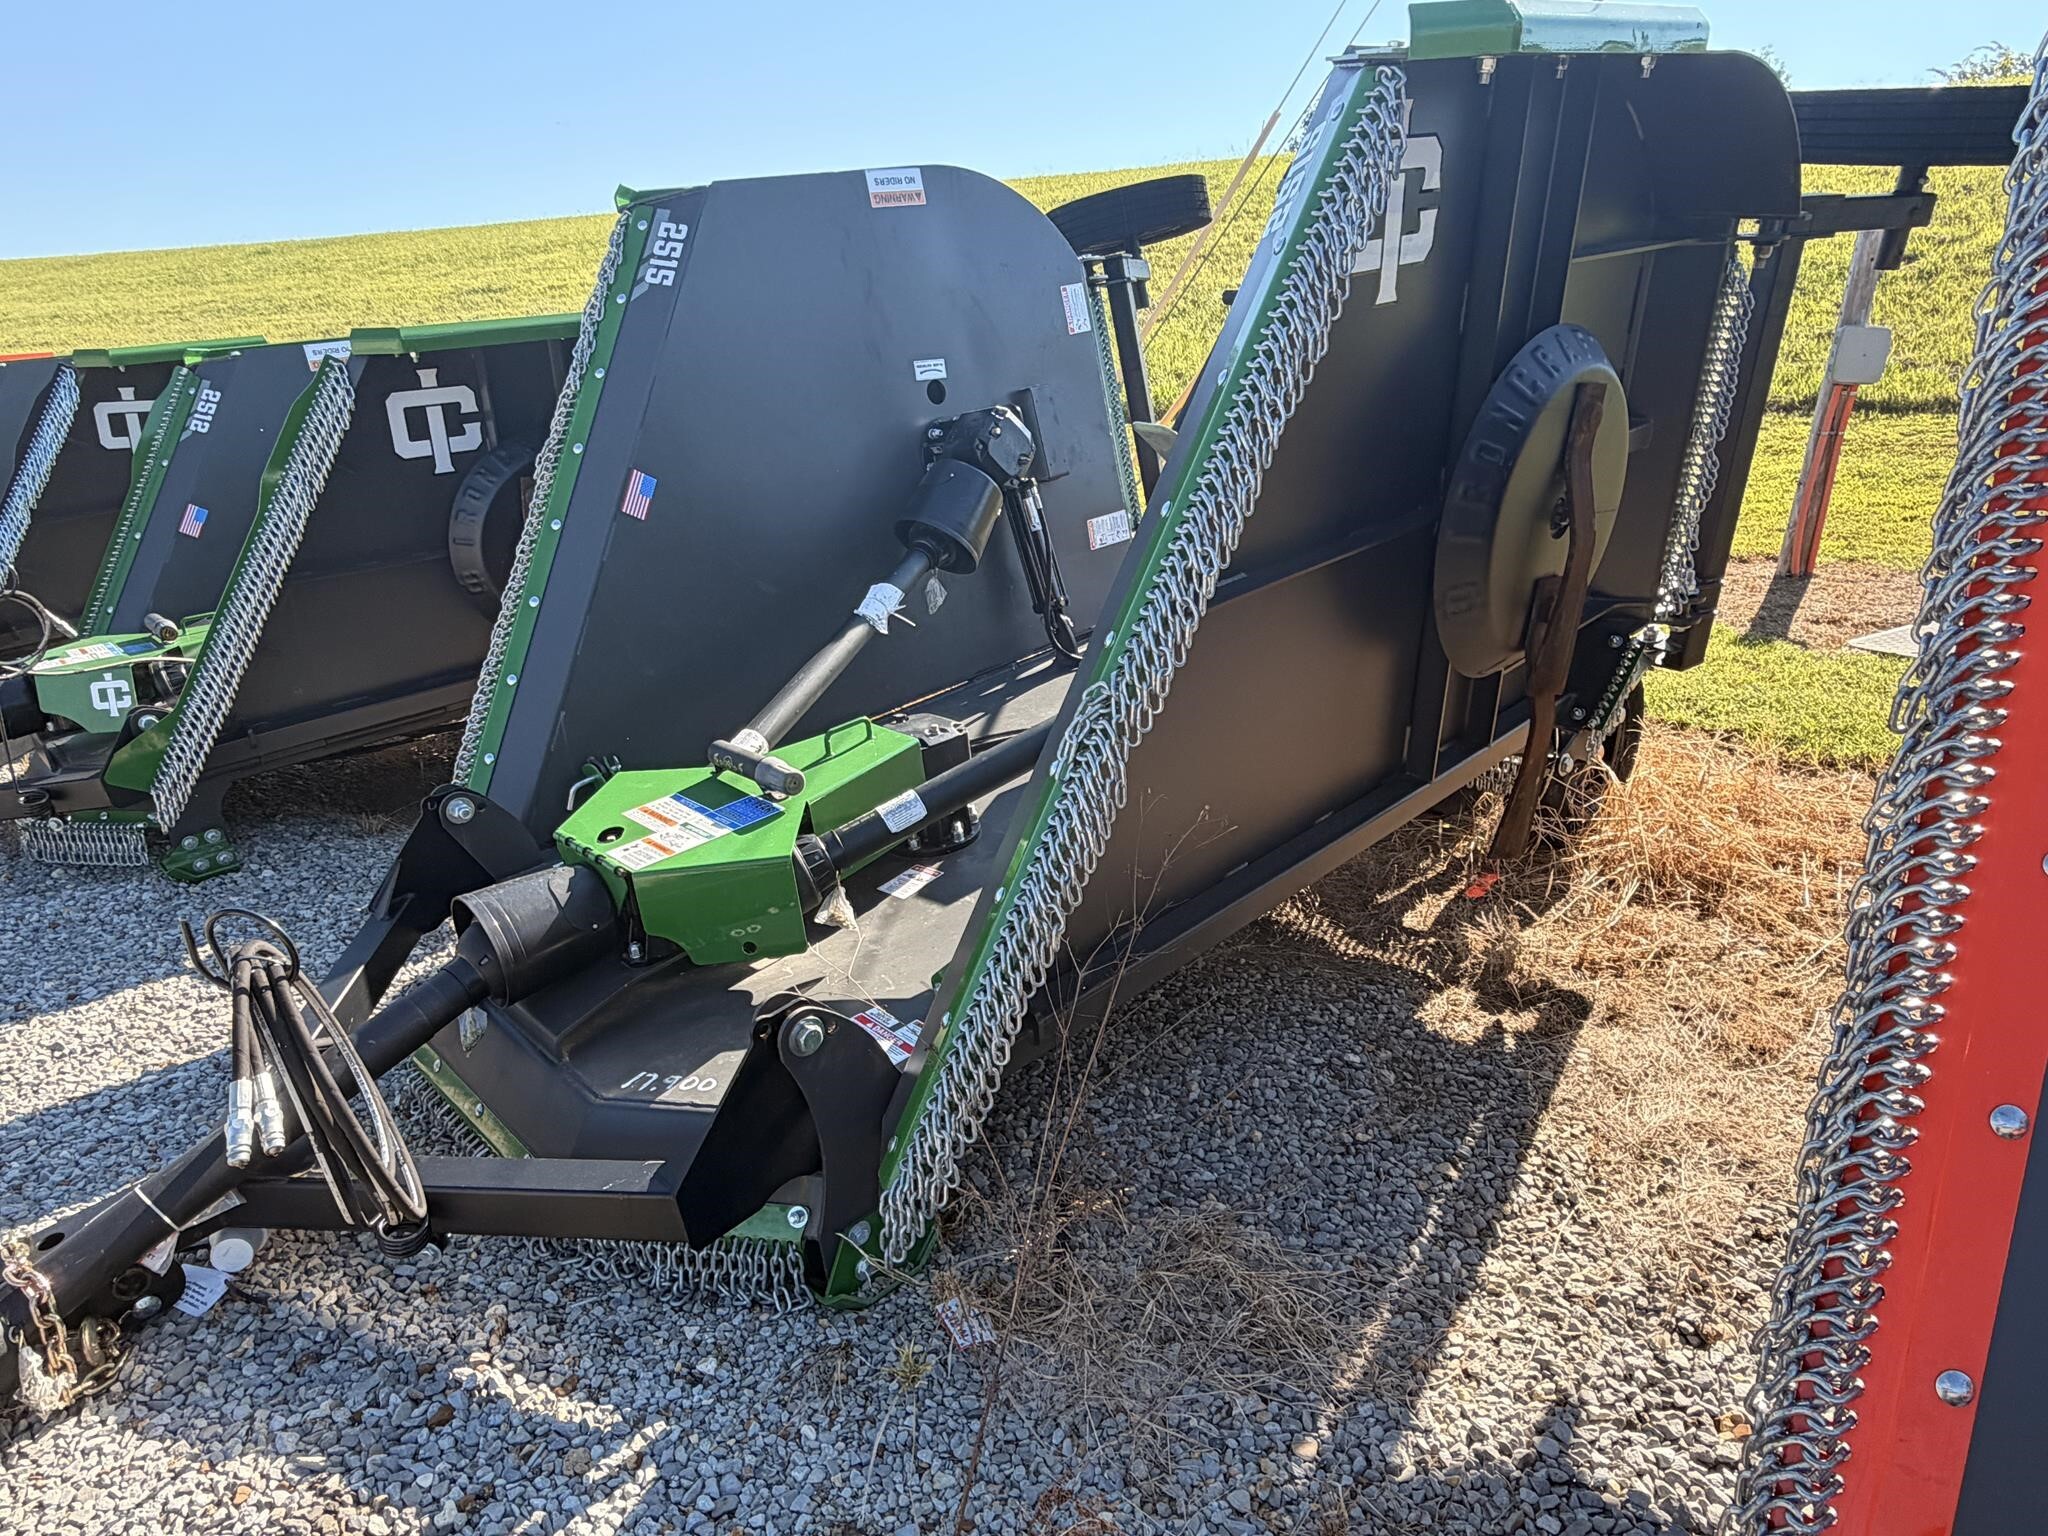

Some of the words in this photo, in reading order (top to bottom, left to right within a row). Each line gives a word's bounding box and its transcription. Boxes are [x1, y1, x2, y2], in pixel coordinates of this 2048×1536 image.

[874, 177, 903, 186] RIDERS
[905, 176, 916, 185] NO
[644, 221, 689, 287] 2515
[189, 388, 222, 433] 2512
[872, 1025, 904, 1047] DANGER
